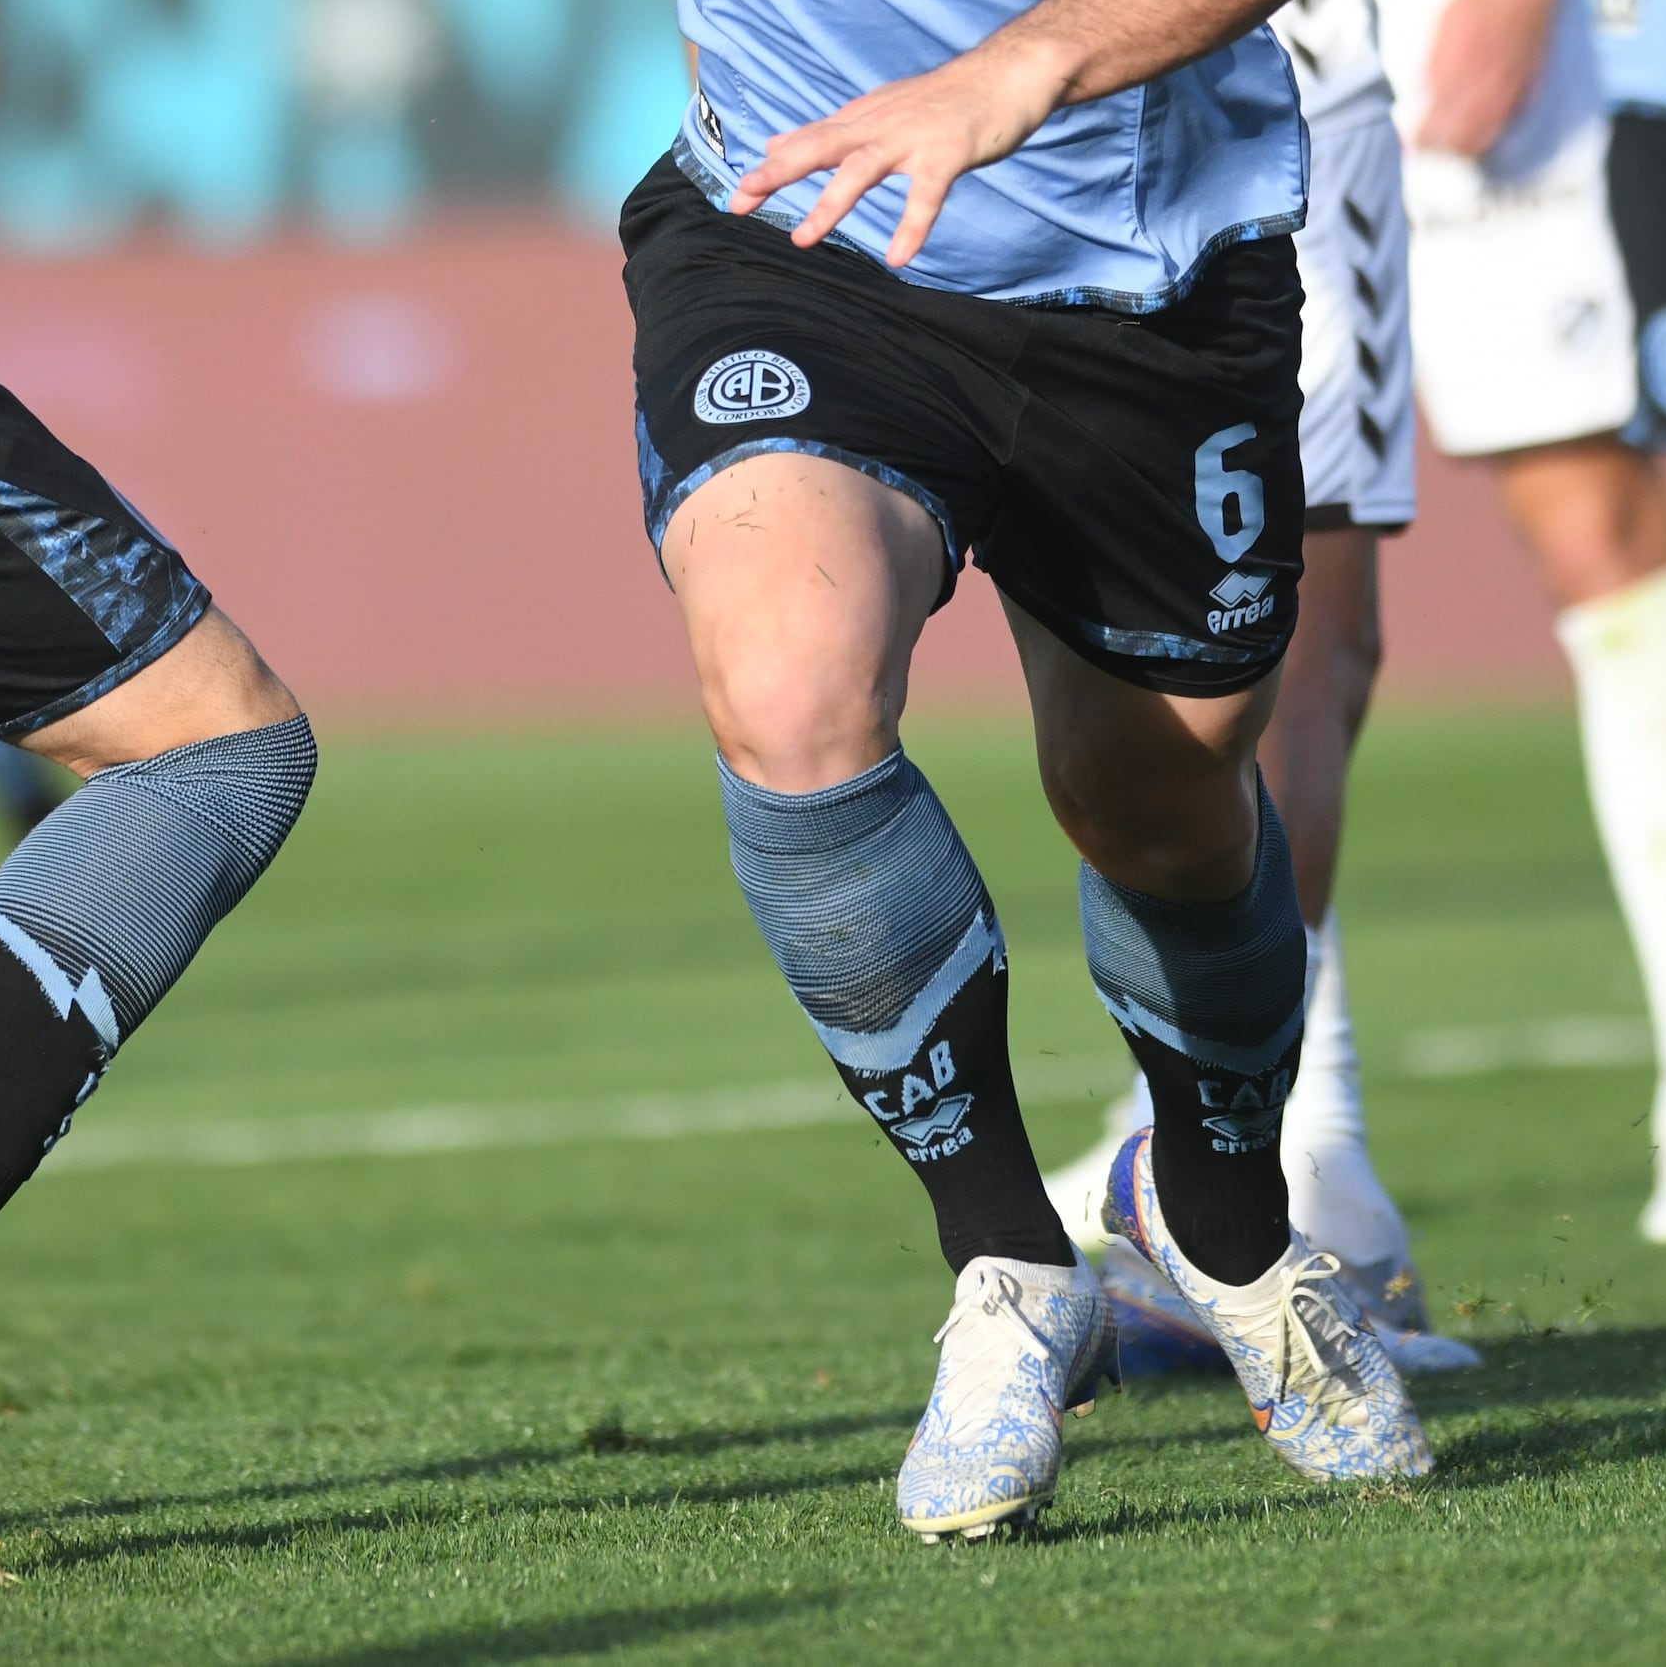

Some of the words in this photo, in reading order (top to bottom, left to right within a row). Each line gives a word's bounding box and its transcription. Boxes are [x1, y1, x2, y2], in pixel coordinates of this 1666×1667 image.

[704, 351, 766, 385] ATLETICO
[770, 355, 807, 407] BELGRANO
[716, 406, 787, 422] CORDOBA
[1194, 420, 1265, 564] 6
[863, 1040, 958, 1122] CAB
[1197, 1068, 1291, 1109] CAB
